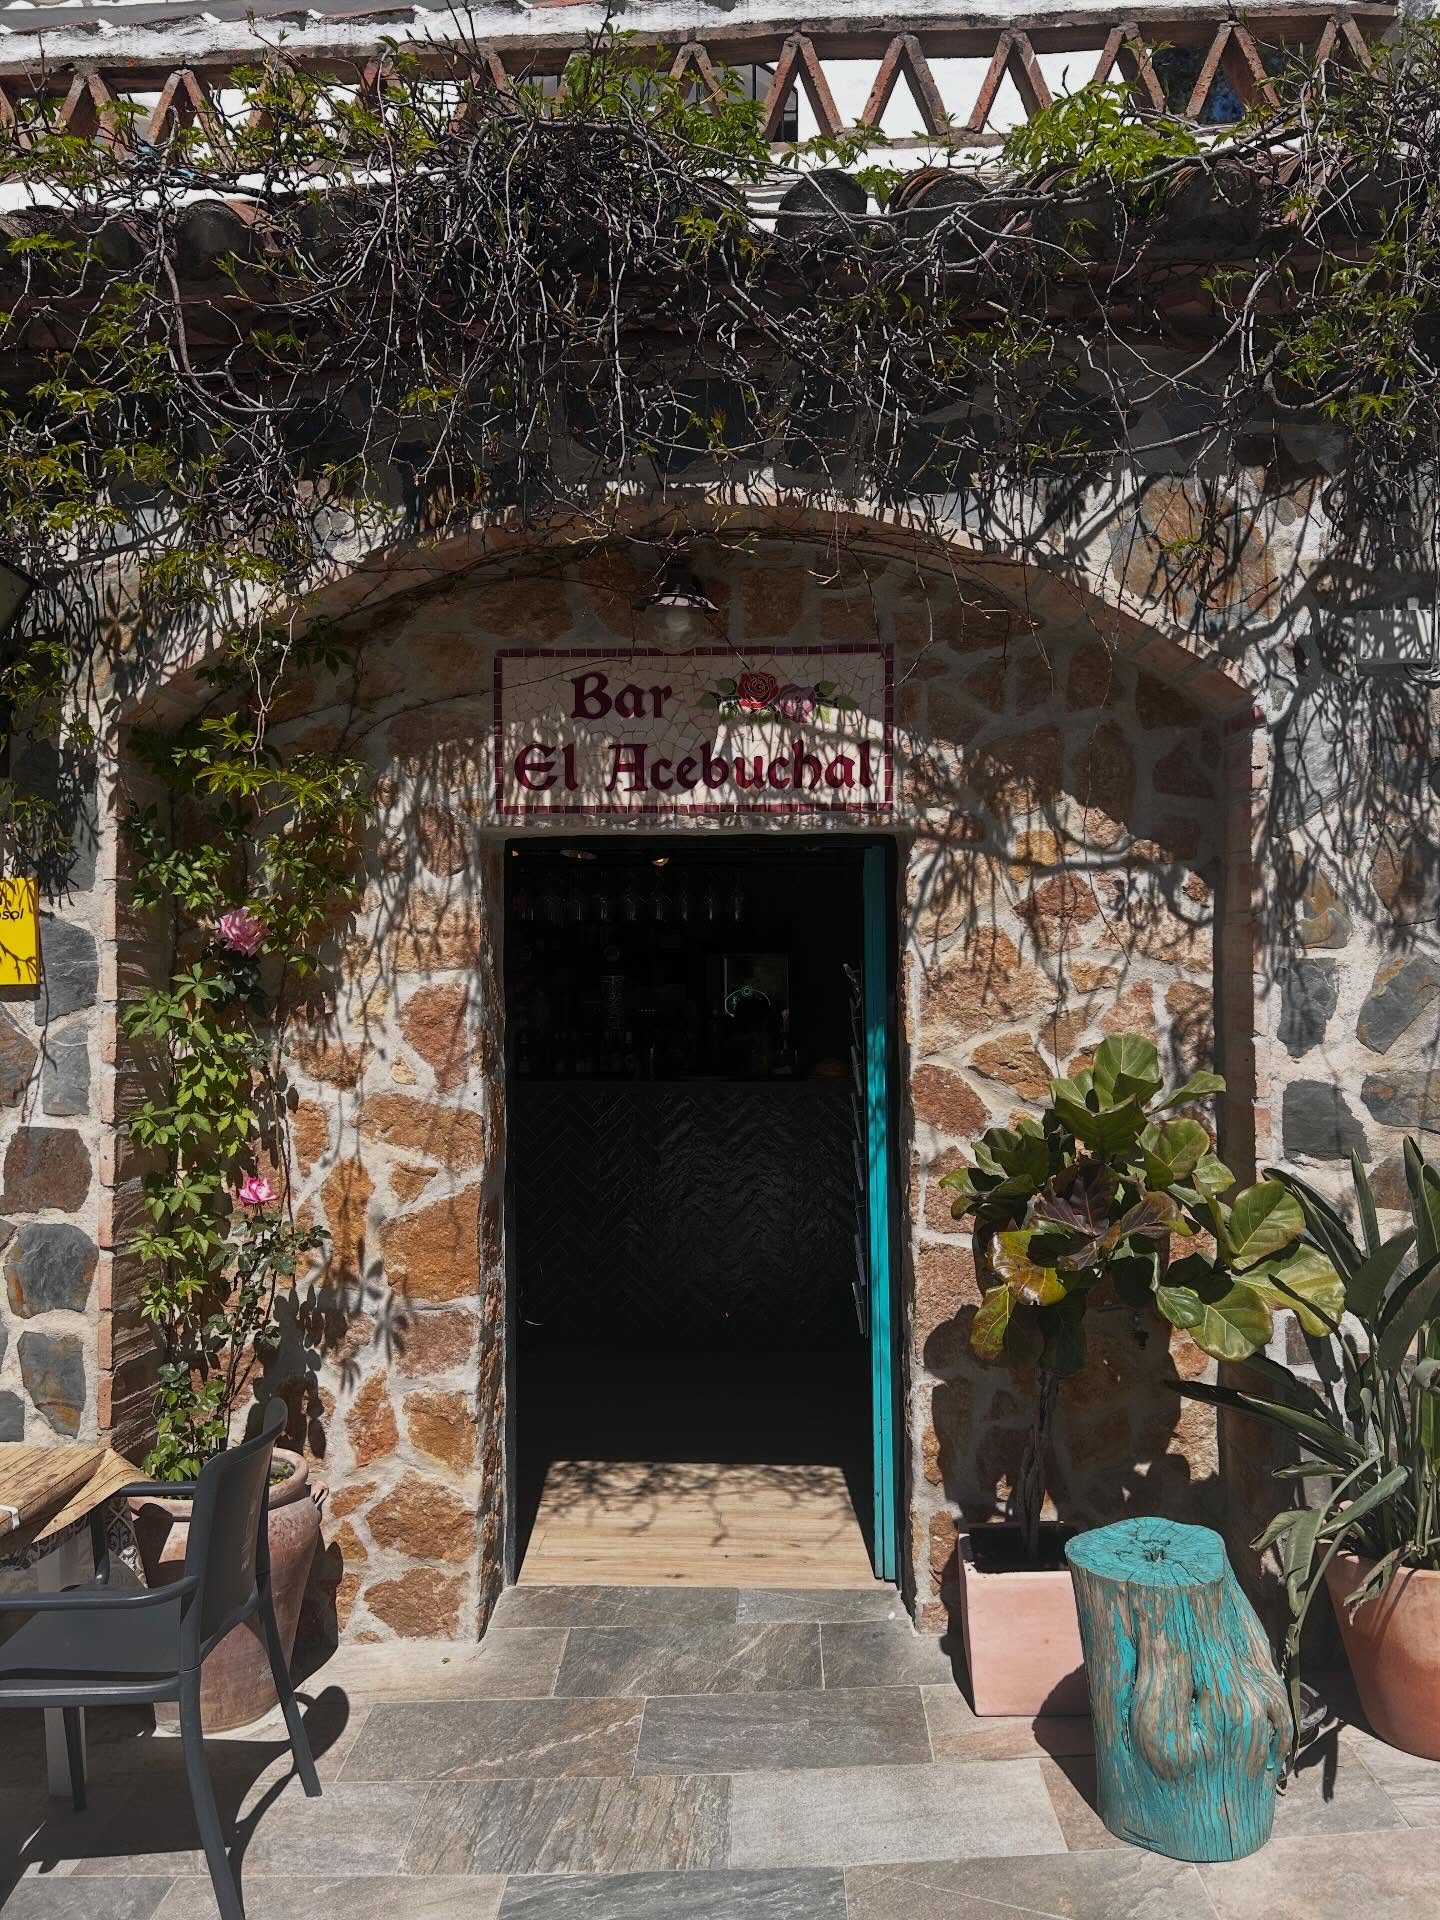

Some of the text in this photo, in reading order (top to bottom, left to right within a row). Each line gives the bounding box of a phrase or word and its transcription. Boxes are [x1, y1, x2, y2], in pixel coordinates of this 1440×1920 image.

[570, 671, 673, 720] Bar
[514, 739, 873, 792] El Acebuchal
[0, 907, 24, 920] sol
